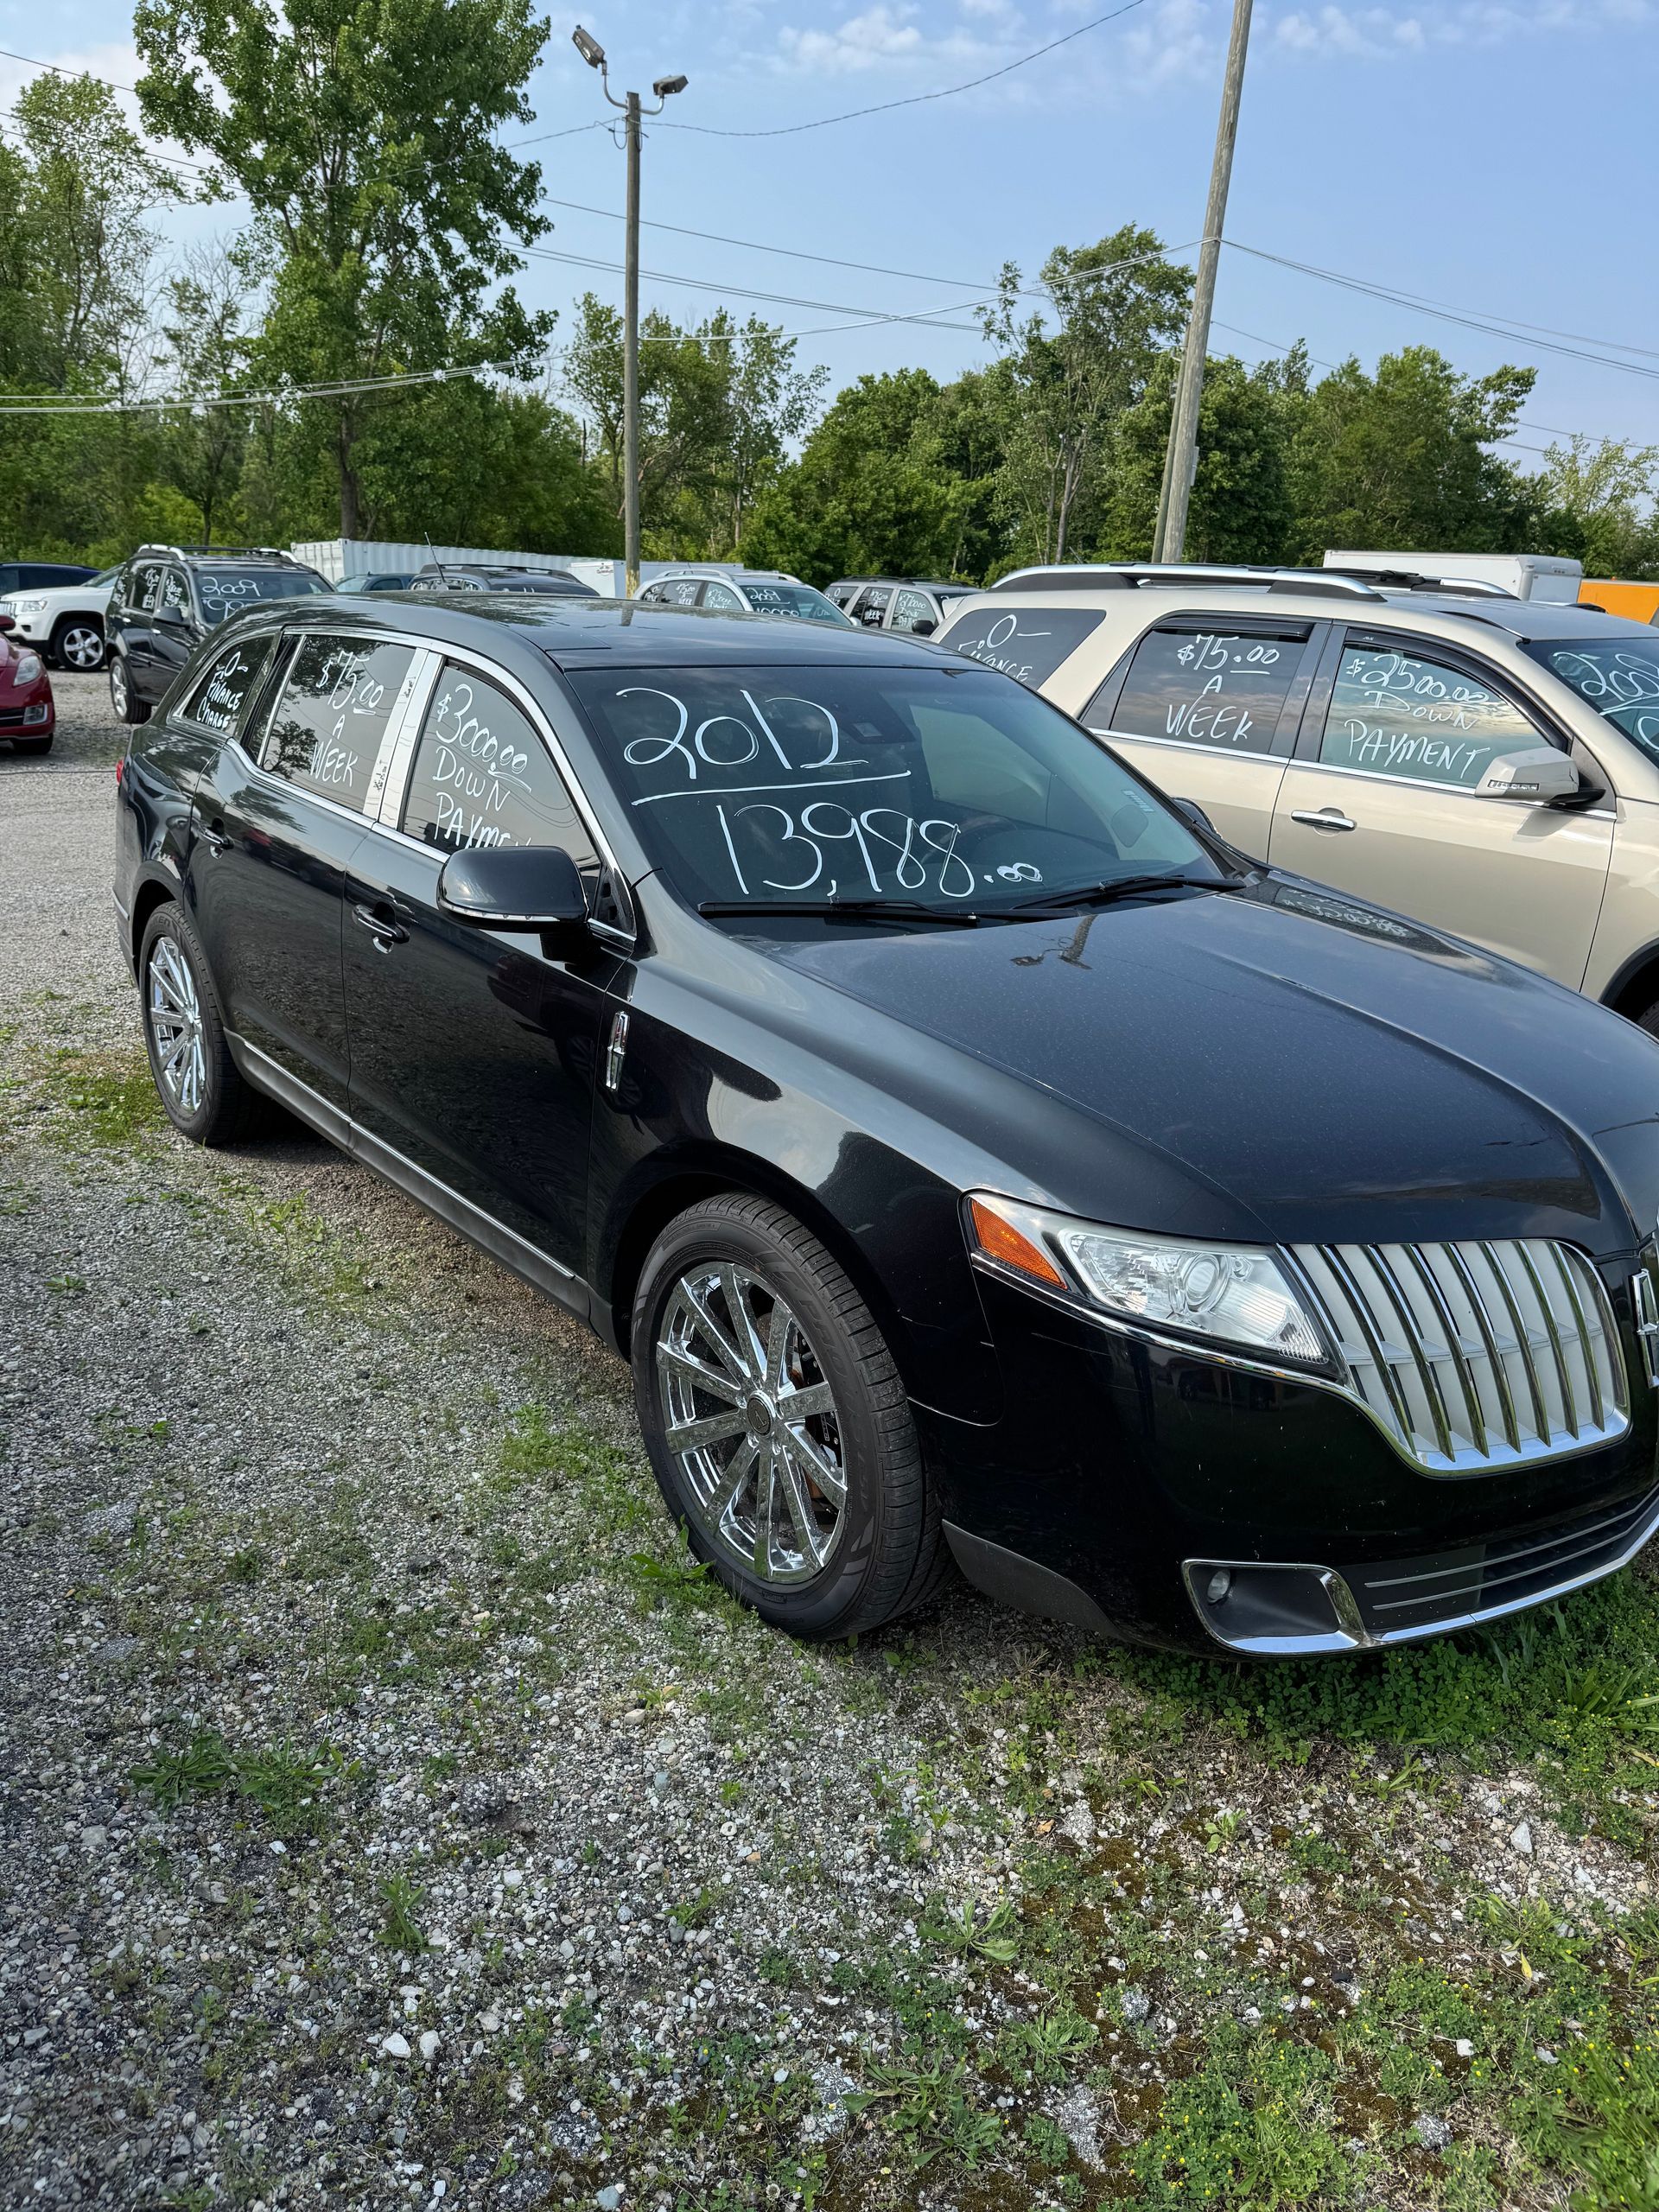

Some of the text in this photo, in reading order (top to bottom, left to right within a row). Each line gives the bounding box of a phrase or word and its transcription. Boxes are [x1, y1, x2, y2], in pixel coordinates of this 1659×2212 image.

[202, 575, 261, 597] 2009
[1177, 634, 1281, 671] $75.00
[207, 671, 244, 711] FINANCE
[315, 650, 385, 710] $75.00
[1202, 675, 1223, 695] A
[1346, 654, 1490, 703] $2500.00
[332, 714, 346, 740] A
[436, 683, 528, 774] $3000.00
[616, 687, 869, 779] 2012
[1166, 696, 1254, 742] WEEK
[309, 739, 359, 788] WEEK
[1344, 719, 1491, 779] PAYMENT
[434, 792, 531, 849] PAYM
[715, 802, 1043, 899] 13,988.00
